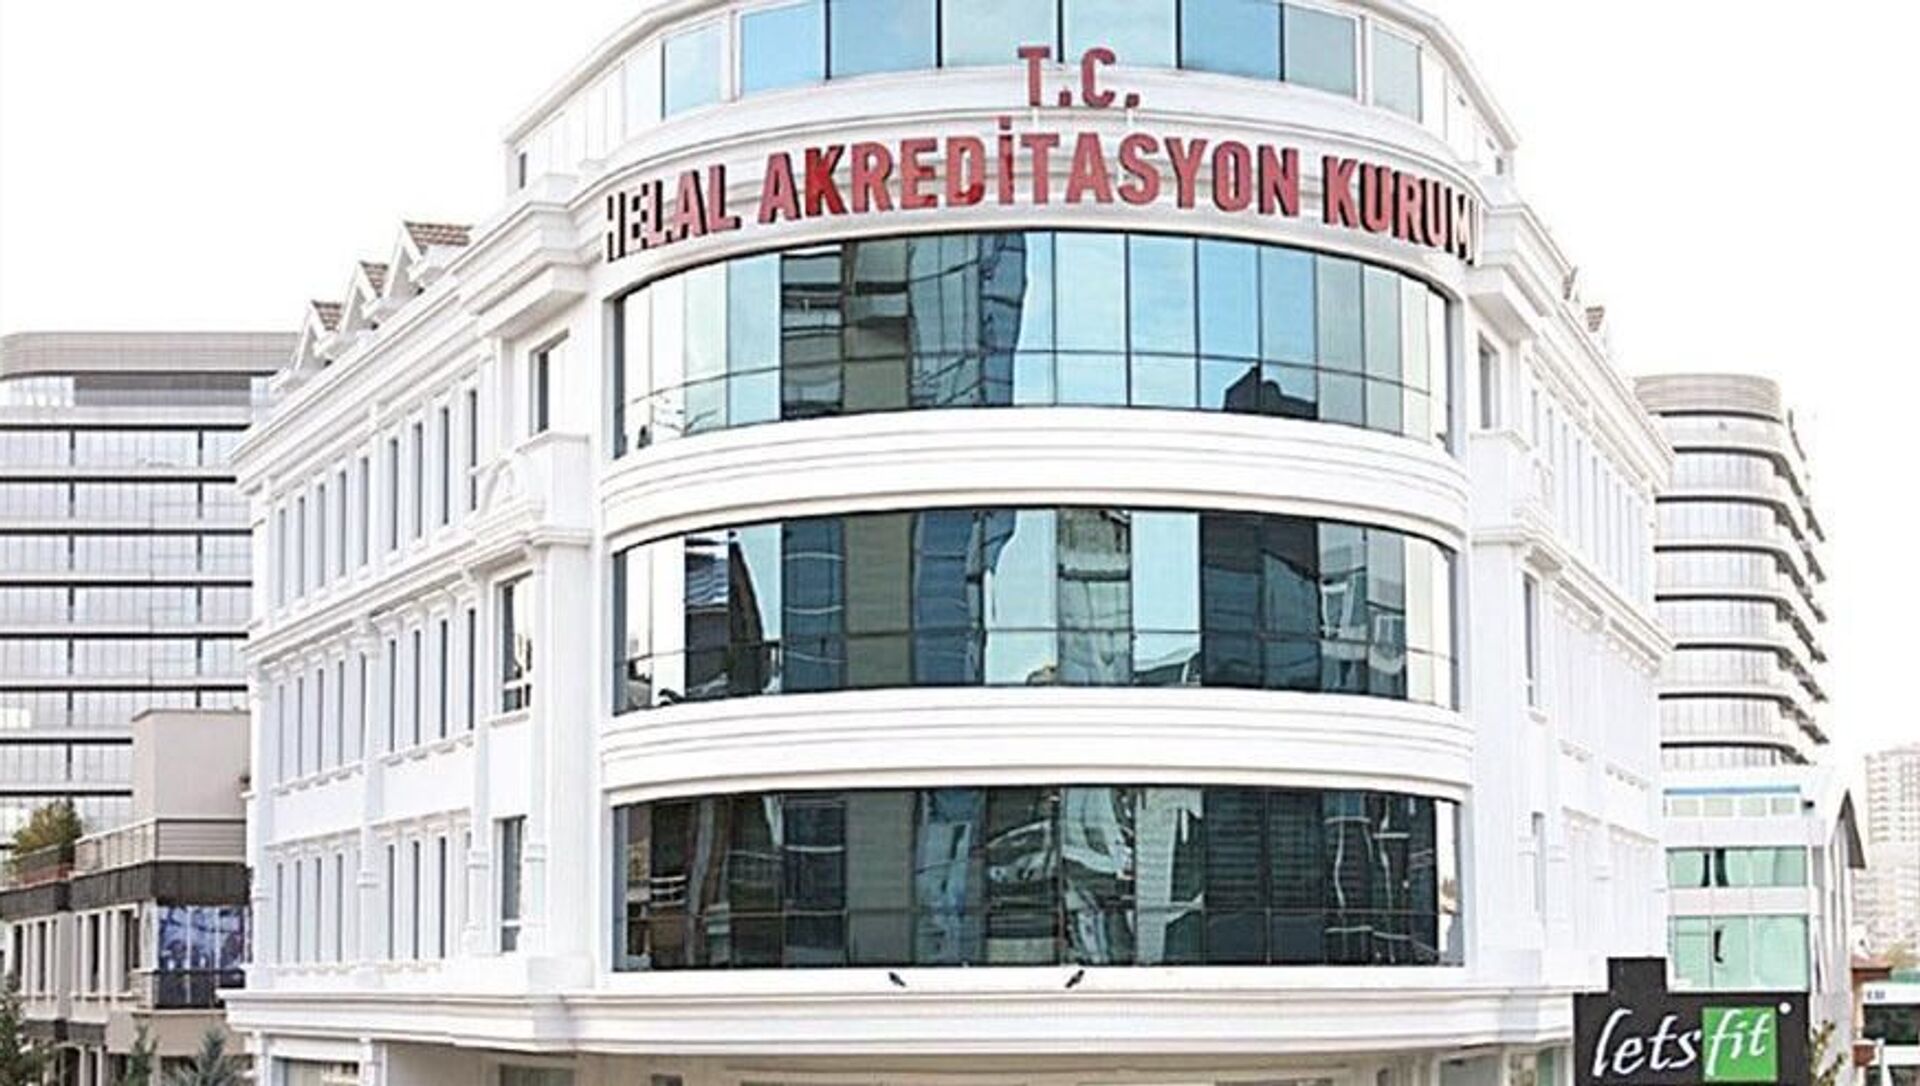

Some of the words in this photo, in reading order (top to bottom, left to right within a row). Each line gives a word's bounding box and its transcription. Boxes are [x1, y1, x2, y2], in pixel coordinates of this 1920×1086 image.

[1017, 46, 1140, 107] T.C.
[607, 164, 742, 263] HELAL
[757, 115, 1300, 226] AKREDİTASYON
